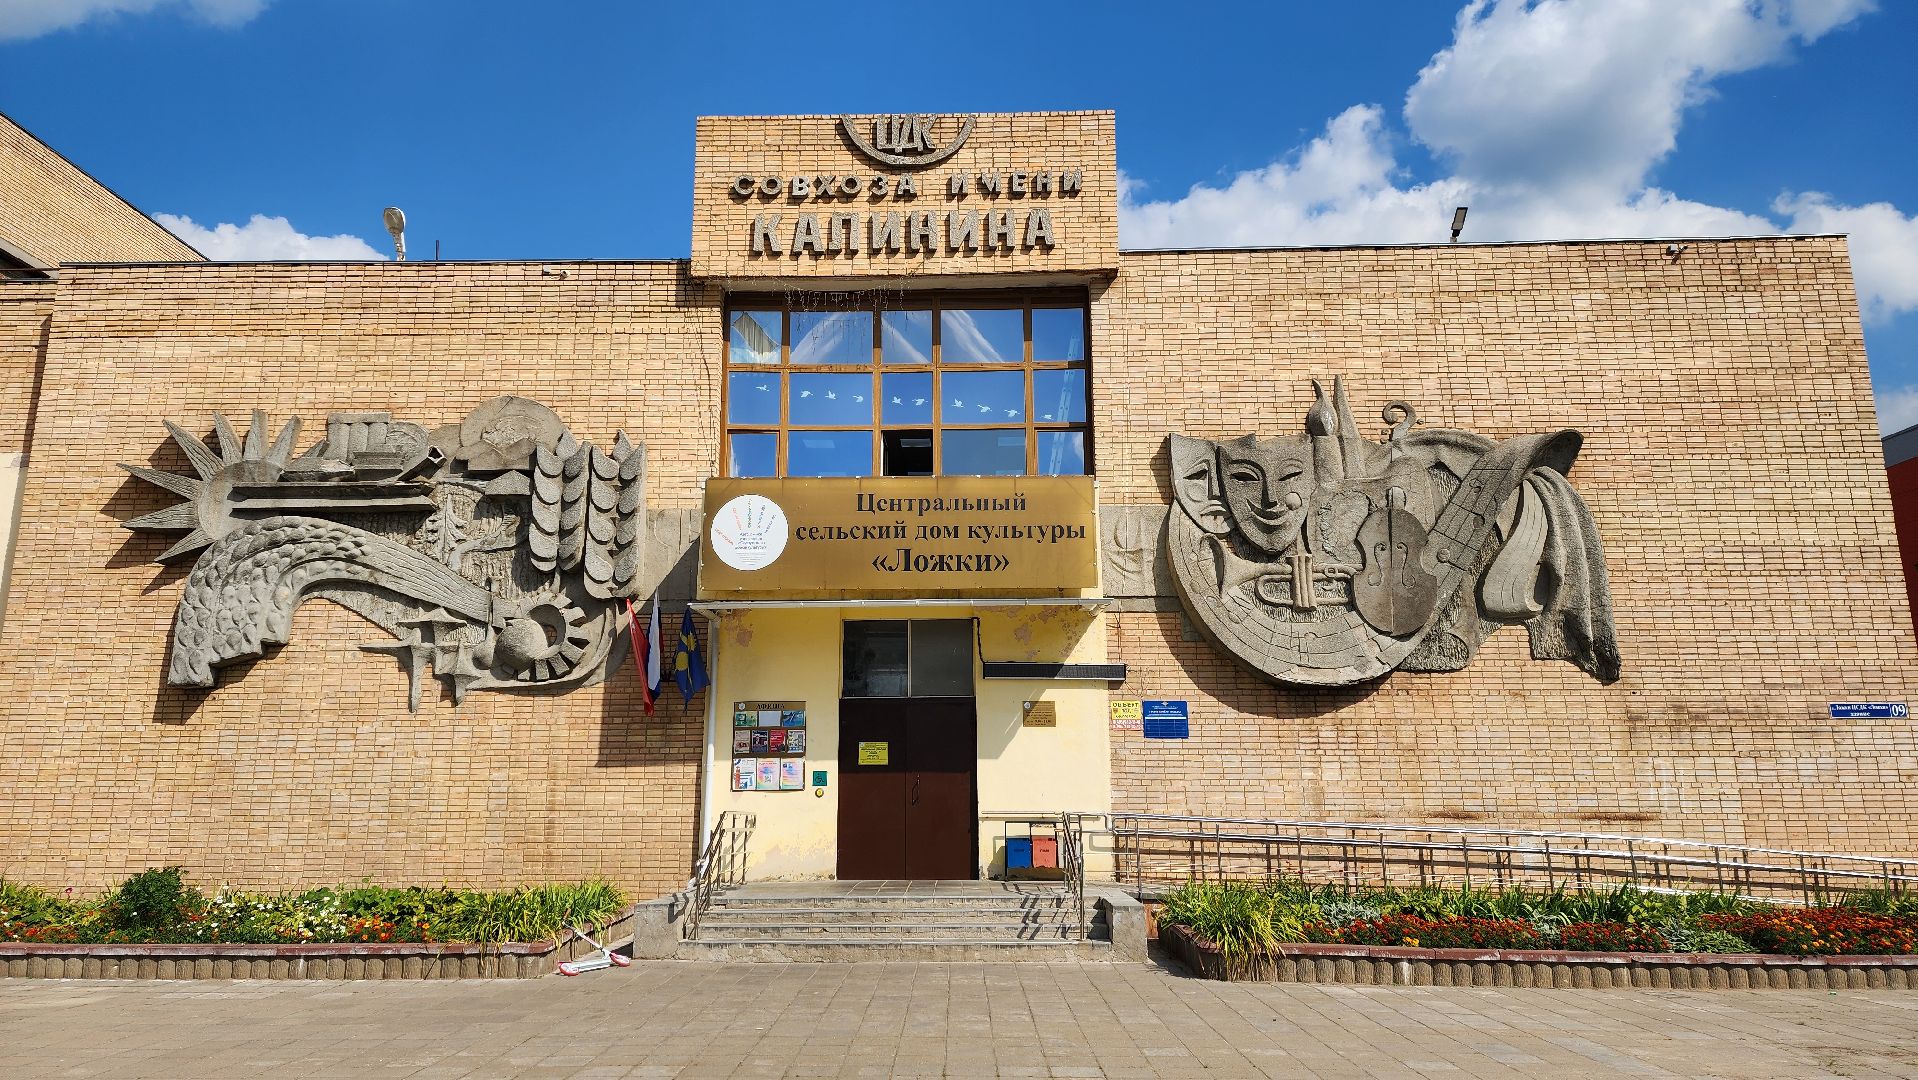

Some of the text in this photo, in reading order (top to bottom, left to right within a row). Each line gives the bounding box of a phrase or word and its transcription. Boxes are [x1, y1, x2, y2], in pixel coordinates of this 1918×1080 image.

[733, 169, 1083, 197] СОВХОЗА ИМЕНИ
[752, 207, 1056, 254] КАЛИНИНА
[856, 492, 1027, 516] Центральный
[795, 520, 907, 541] сельский
[914, 525, 960, 541] дом
[967, 524, 1086, 544] культуры
[871, 548, 1010, 573] «Ложки»
[1891, 704, 1906, 717] 09
